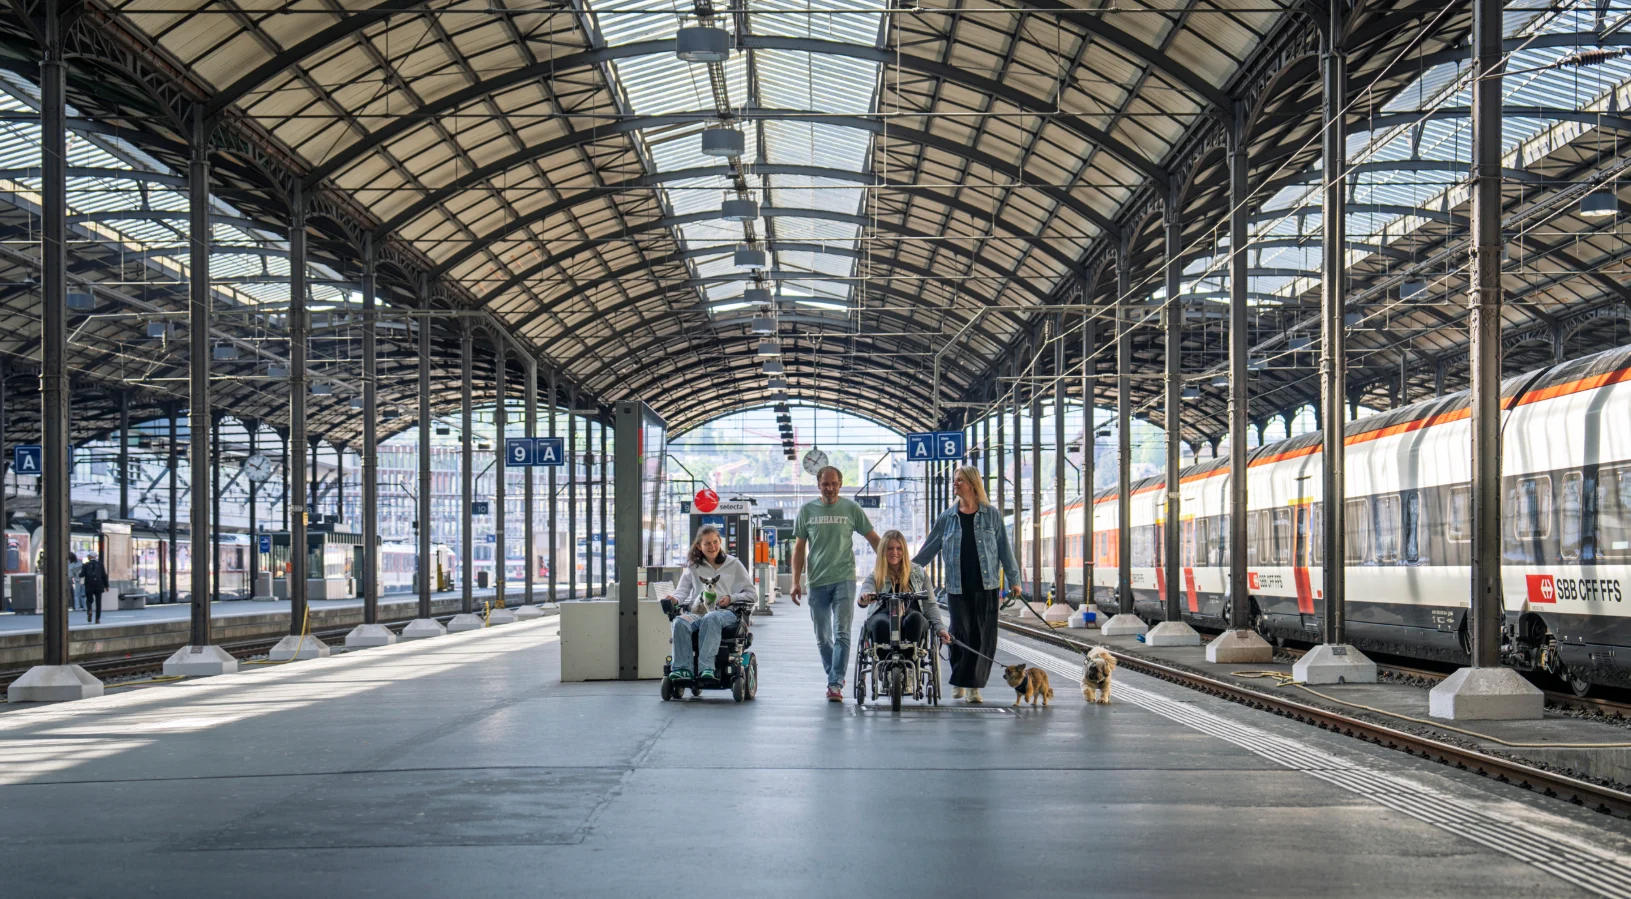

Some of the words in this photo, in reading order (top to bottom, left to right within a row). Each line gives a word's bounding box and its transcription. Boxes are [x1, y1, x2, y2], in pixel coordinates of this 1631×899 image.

[514, 446, 526, 462] 9
[543, 446, 556, 461] A
[915, 441, 928, 457] A
[944, 440, 956, 456] 8
[22, 454, 36, 470] A
[477, 505, 487, 513] 10
[684, 504, 690, 512] 9
[809, 515, 849, 525] CARHARTT
[1556, 578, 1578, 600] SBB
[1578, 578, 1599, 602] CFF
[1599, 579, 1622, 603] FFS
